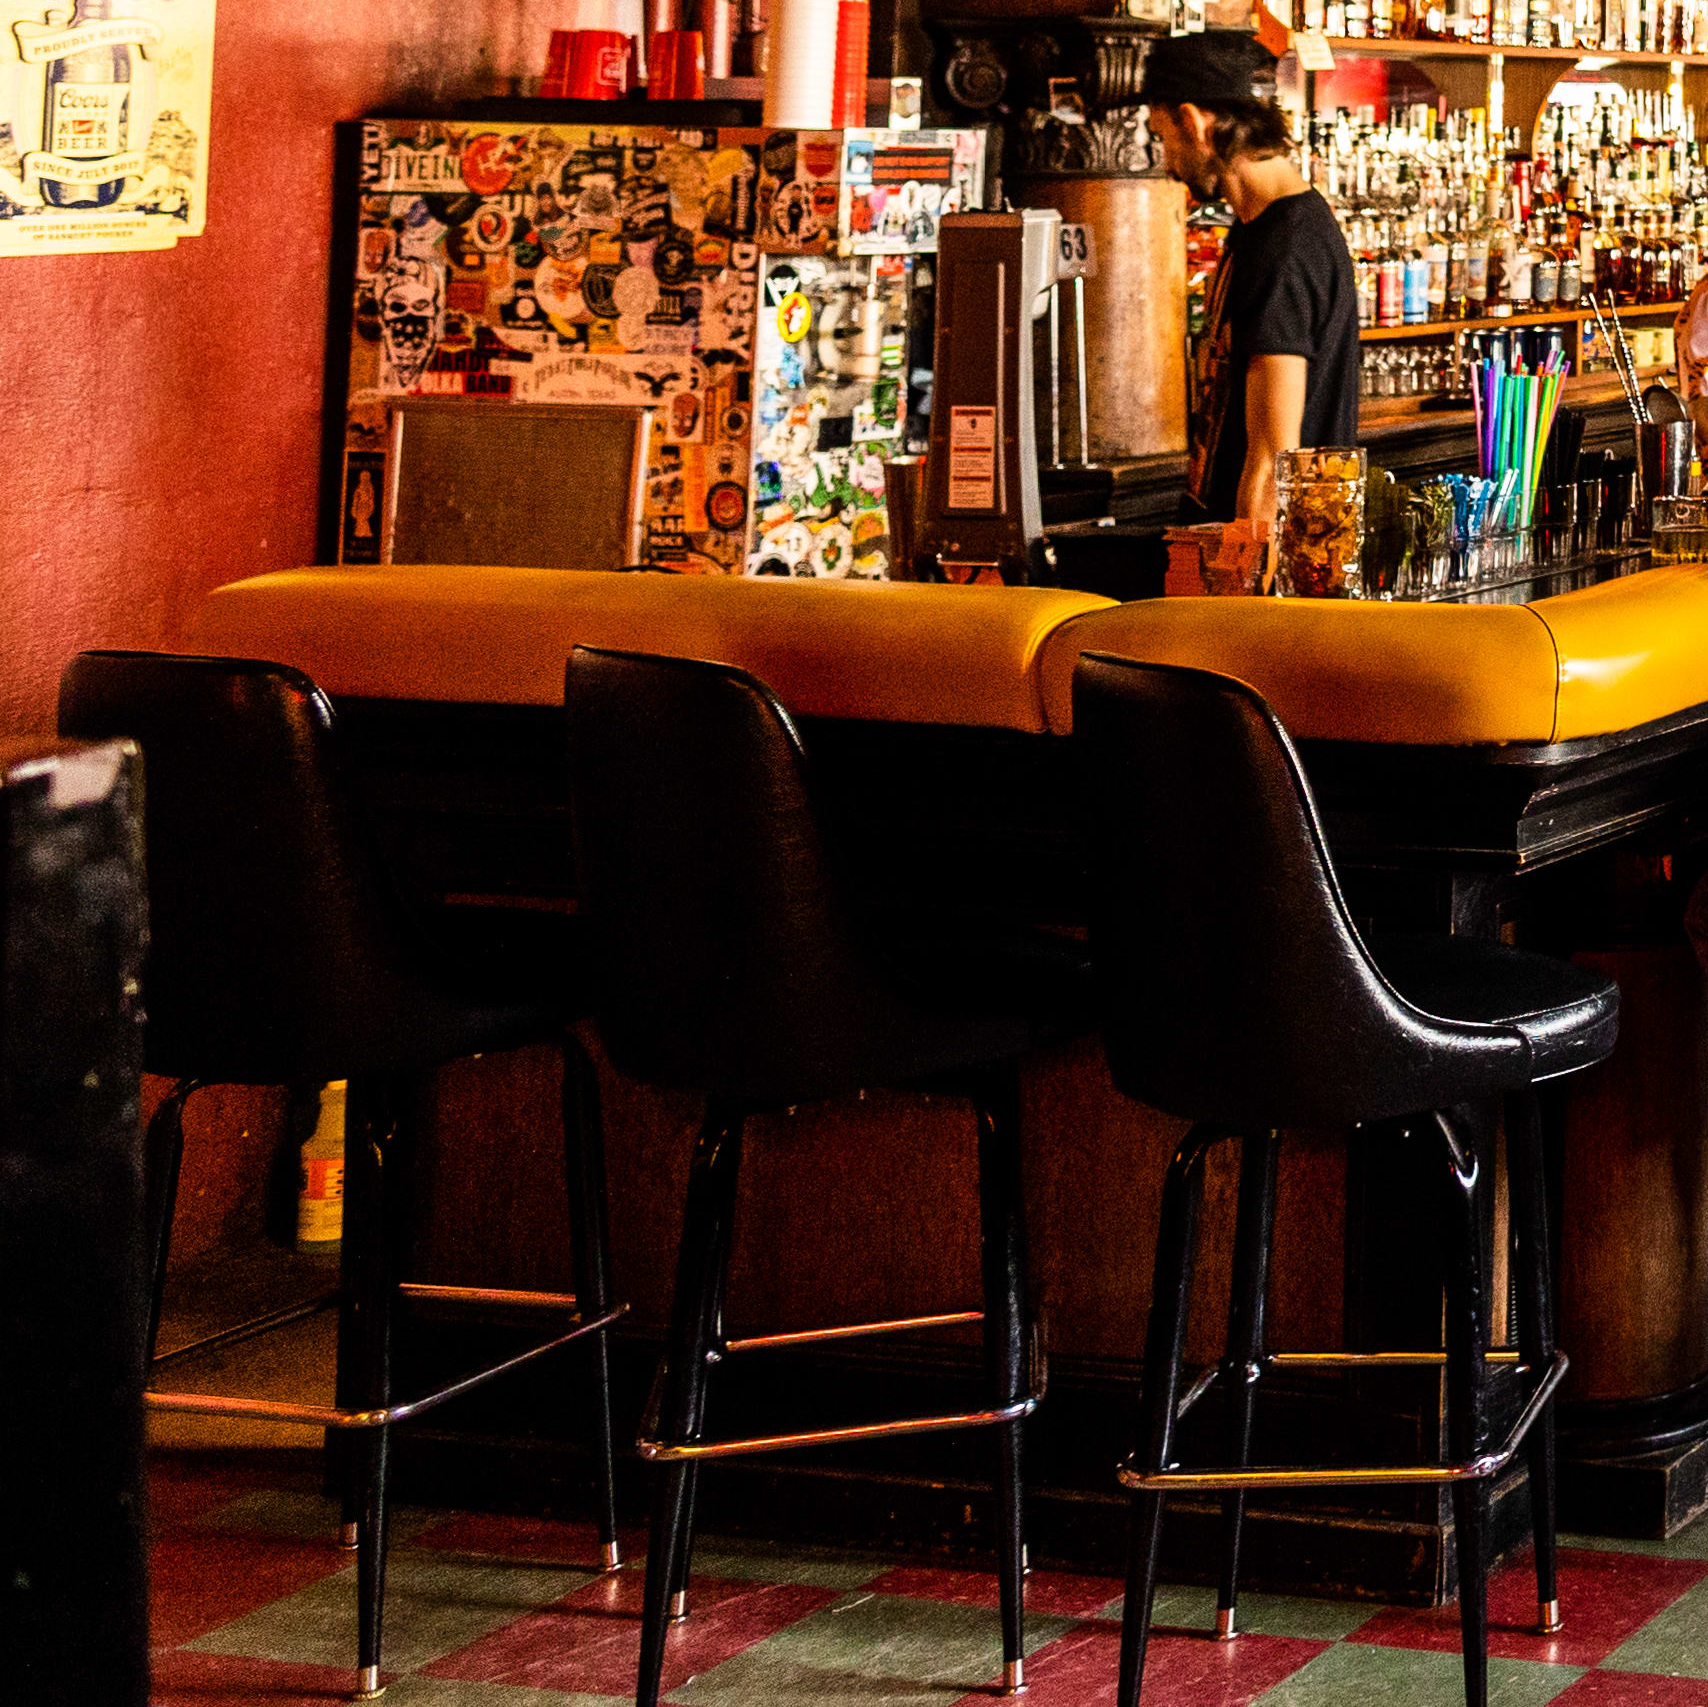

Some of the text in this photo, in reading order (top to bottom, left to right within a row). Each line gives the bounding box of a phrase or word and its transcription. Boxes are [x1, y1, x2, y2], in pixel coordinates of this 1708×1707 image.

[33, 32, 97, 55] PROUDLY
[58, 89, 109, 110] Coors
[56, 138, 108, 150] BEER
[33, 161, 72, 178] SINCE
[78, 165, 108, 179] JULY
[1060, 227, 1088, 260] 63
